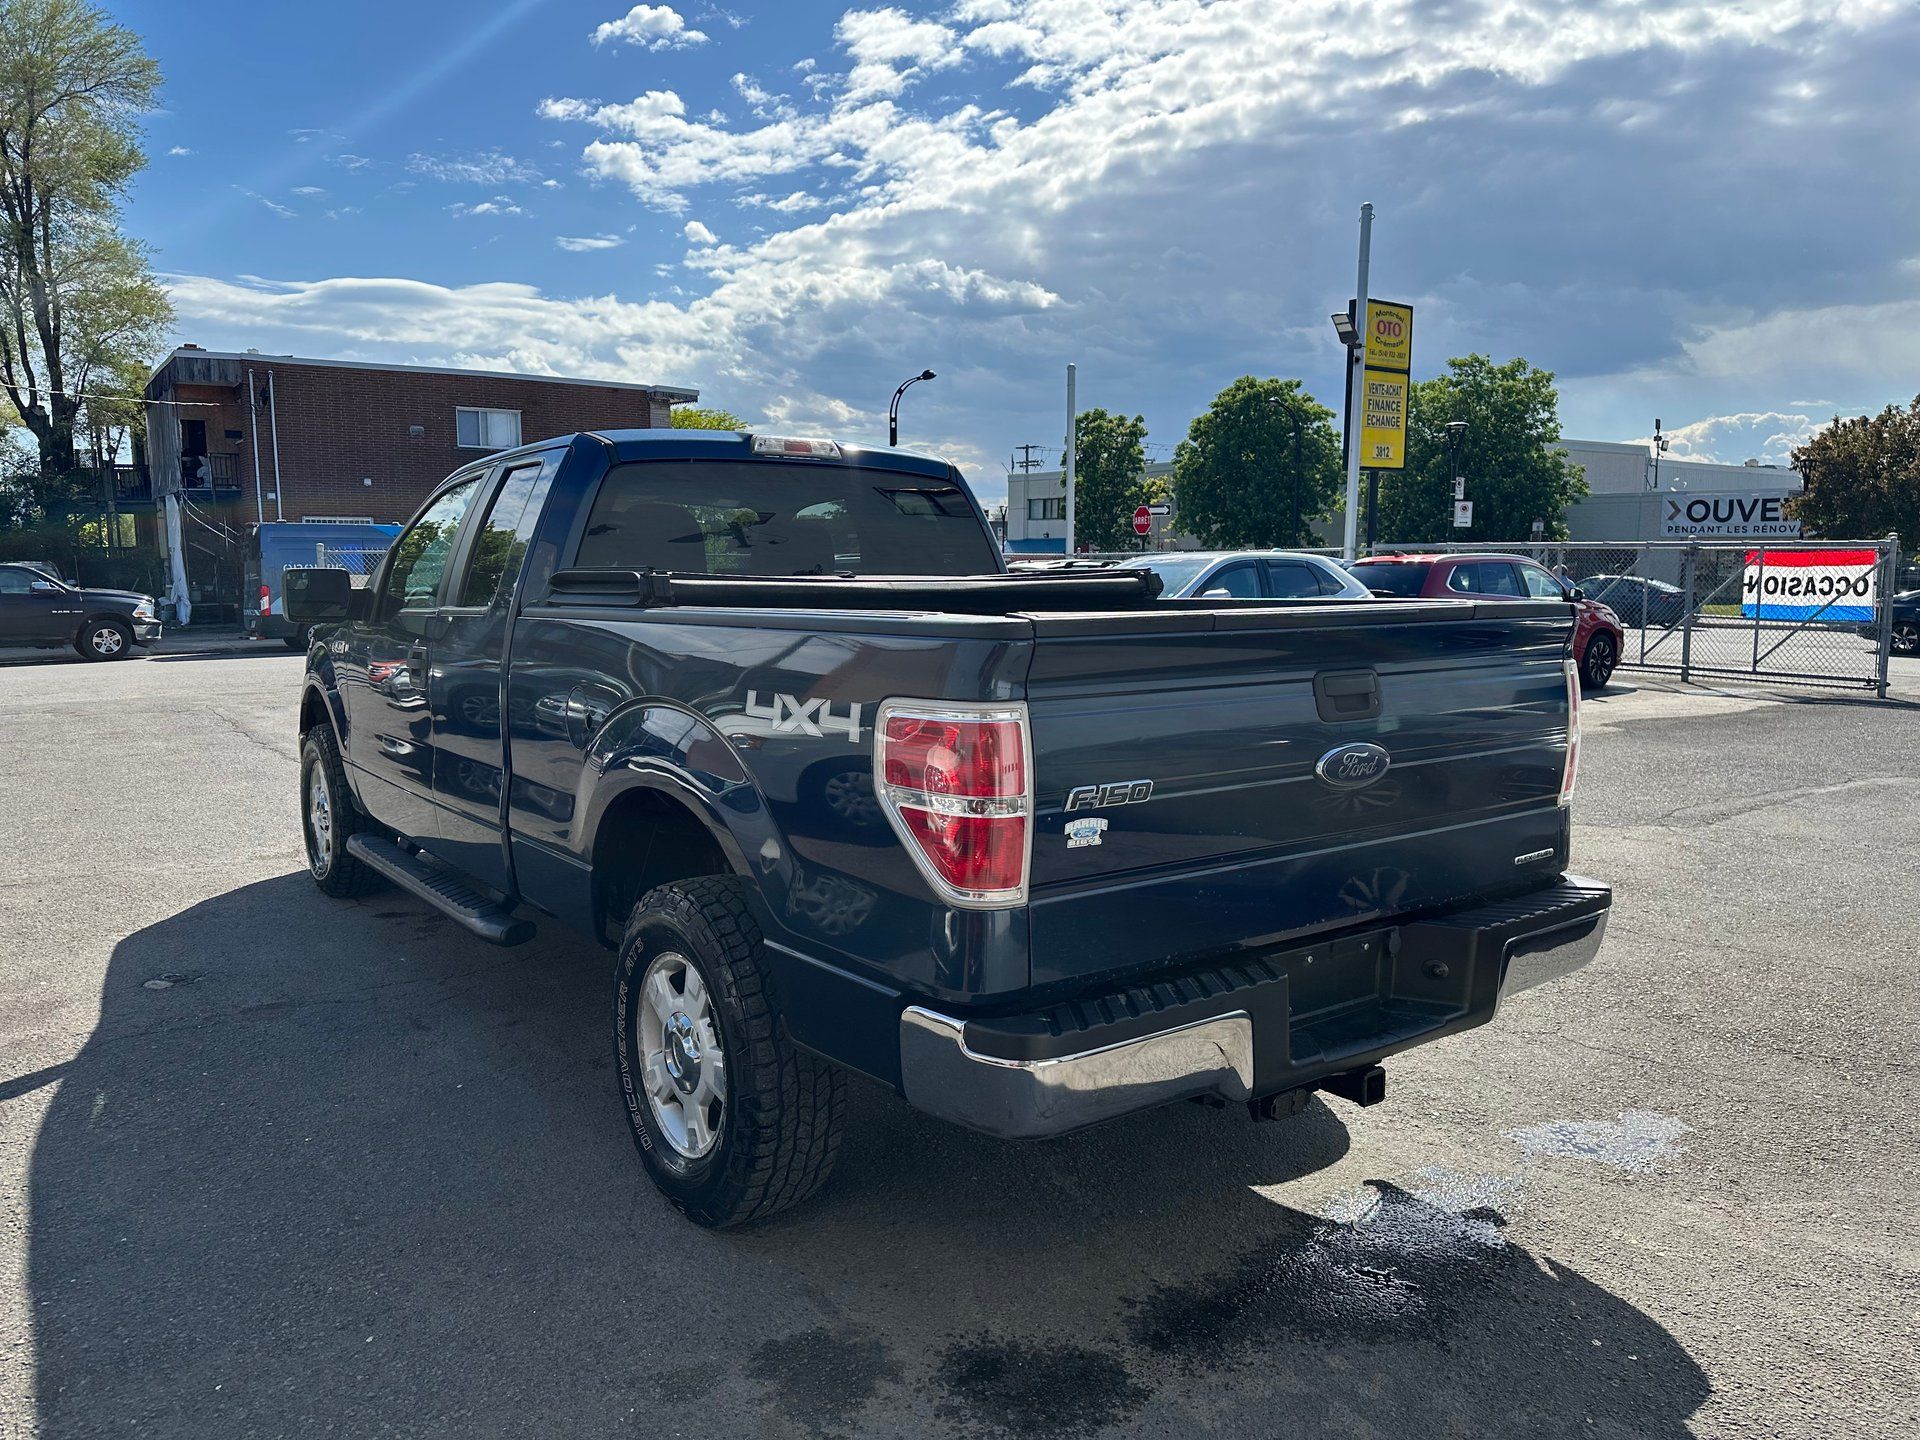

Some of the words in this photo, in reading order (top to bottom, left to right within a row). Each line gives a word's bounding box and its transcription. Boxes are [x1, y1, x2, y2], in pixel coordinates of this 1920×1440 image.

[1375, 310, 1404, 323] Montréal
[1377, 320, 1402, 337] OTO
[1368, 383, 1402, 397] VENTE-ACHAT
[1367, 399, 1401, 412] FINANCE
[1366, 414, 1401, 428] ECHANGE
[1375, 446, 1390, 458] 3812
[1667, 525, 1722, 534] PENDANT
[1727, 525, 1748, 534] LES
[1338, 751, 1379, 779] Ford
[1063, 779, 1154, 813] F-150
[624, 937, 645, 976] AT3
[617, 981, 653, 1151] DISCOVERER
